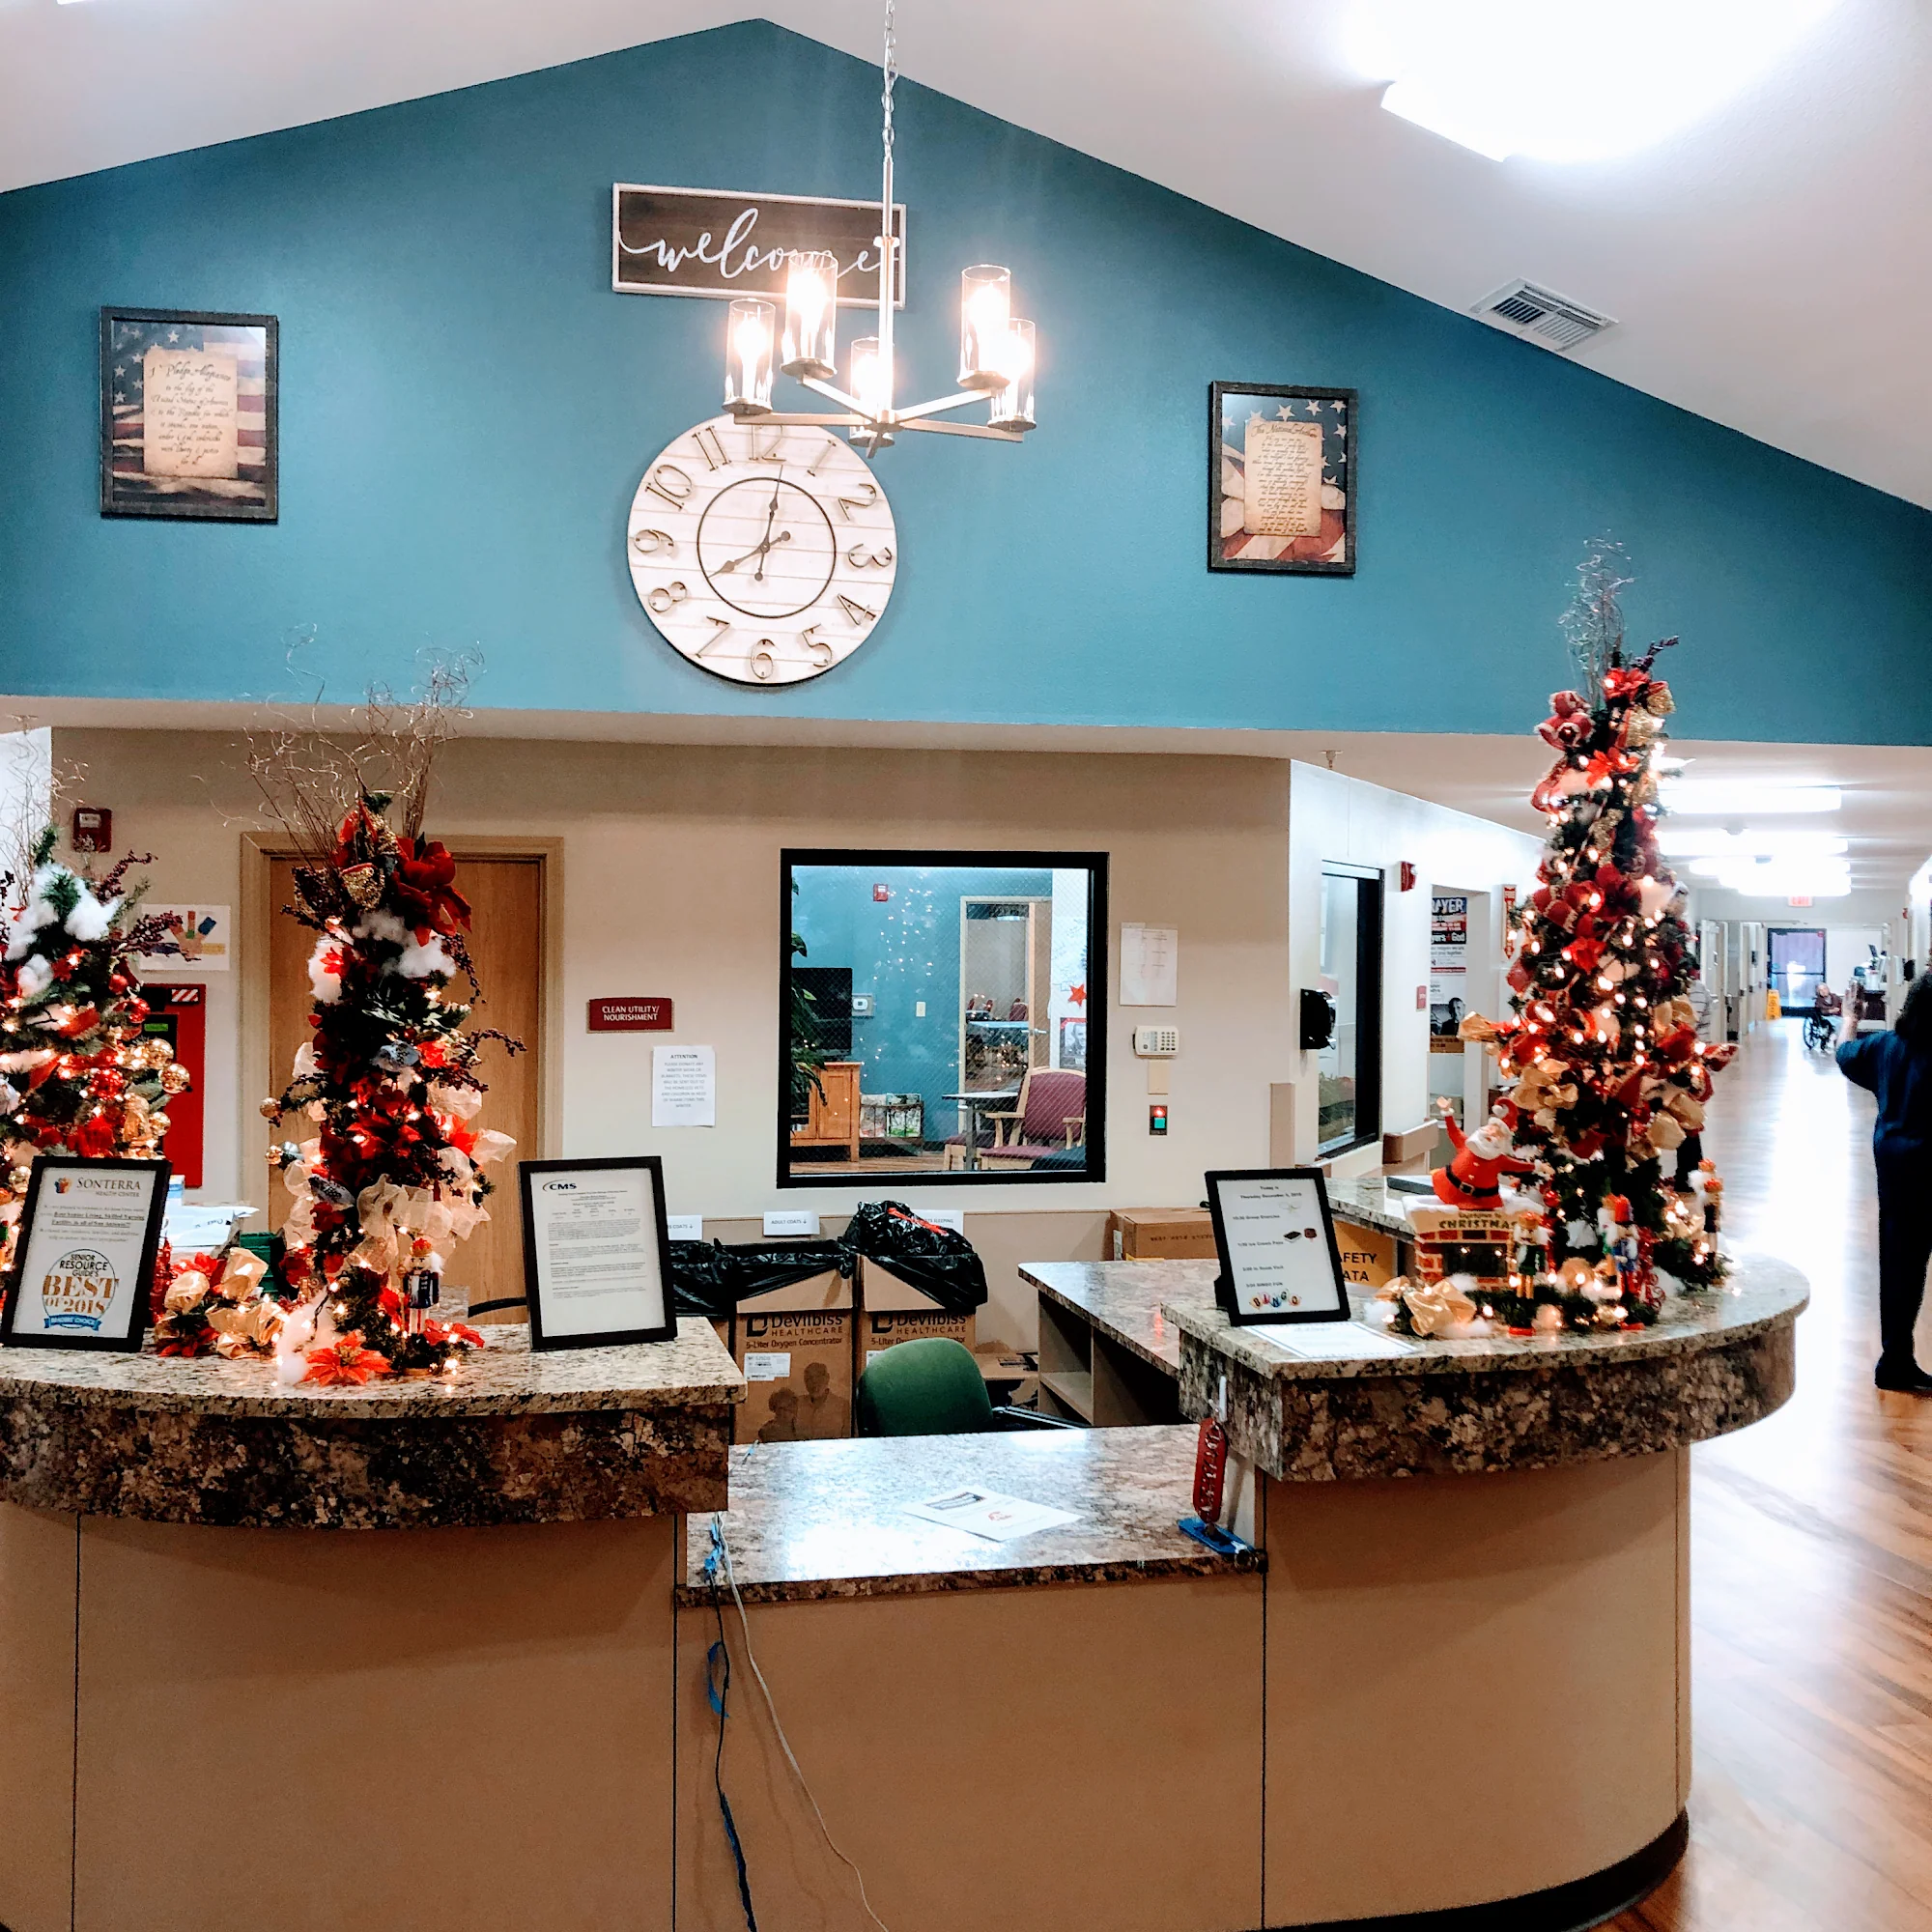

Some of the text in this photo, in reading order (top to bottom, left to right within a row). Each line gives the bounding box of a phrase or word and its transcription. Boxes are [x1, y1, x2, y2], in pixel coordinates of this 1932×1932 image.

[645, 464, 693, 511] 10
[838, 483, 876, 521] 2
[634, 528, 674, 555] 9
[848, 543, 892, 568] 3
[648, 582, 687, 612] 8
[838, 593, 876, 625] 4
[695, 616, 730, 658] 7
[802, 624, 833, 668] 5
[750, 639, 780, 679] 6
[602, 1006, 660, 1014] CLEAN UTILITY/
[76, 1177, 141, 1190] SONTERRA
[549, 1182, 577, 1191] CMS
[59, 1260, 108, 1271] RESOURCE
[1341, 1253, 1378, 1264] FETY
[1344, 1270, 1370, 1282] ATA
[43, 1274, 120, 1299] BEST
[771, 1326, 843, 1337] HEALTHCARE
[896, 1325, 966, 1335] HEALTHCARE
[746, 1337, 842, 1350] 5-Liter Oxygen Concentrator
[870, 1337, 895, 1346] 5-Liter
